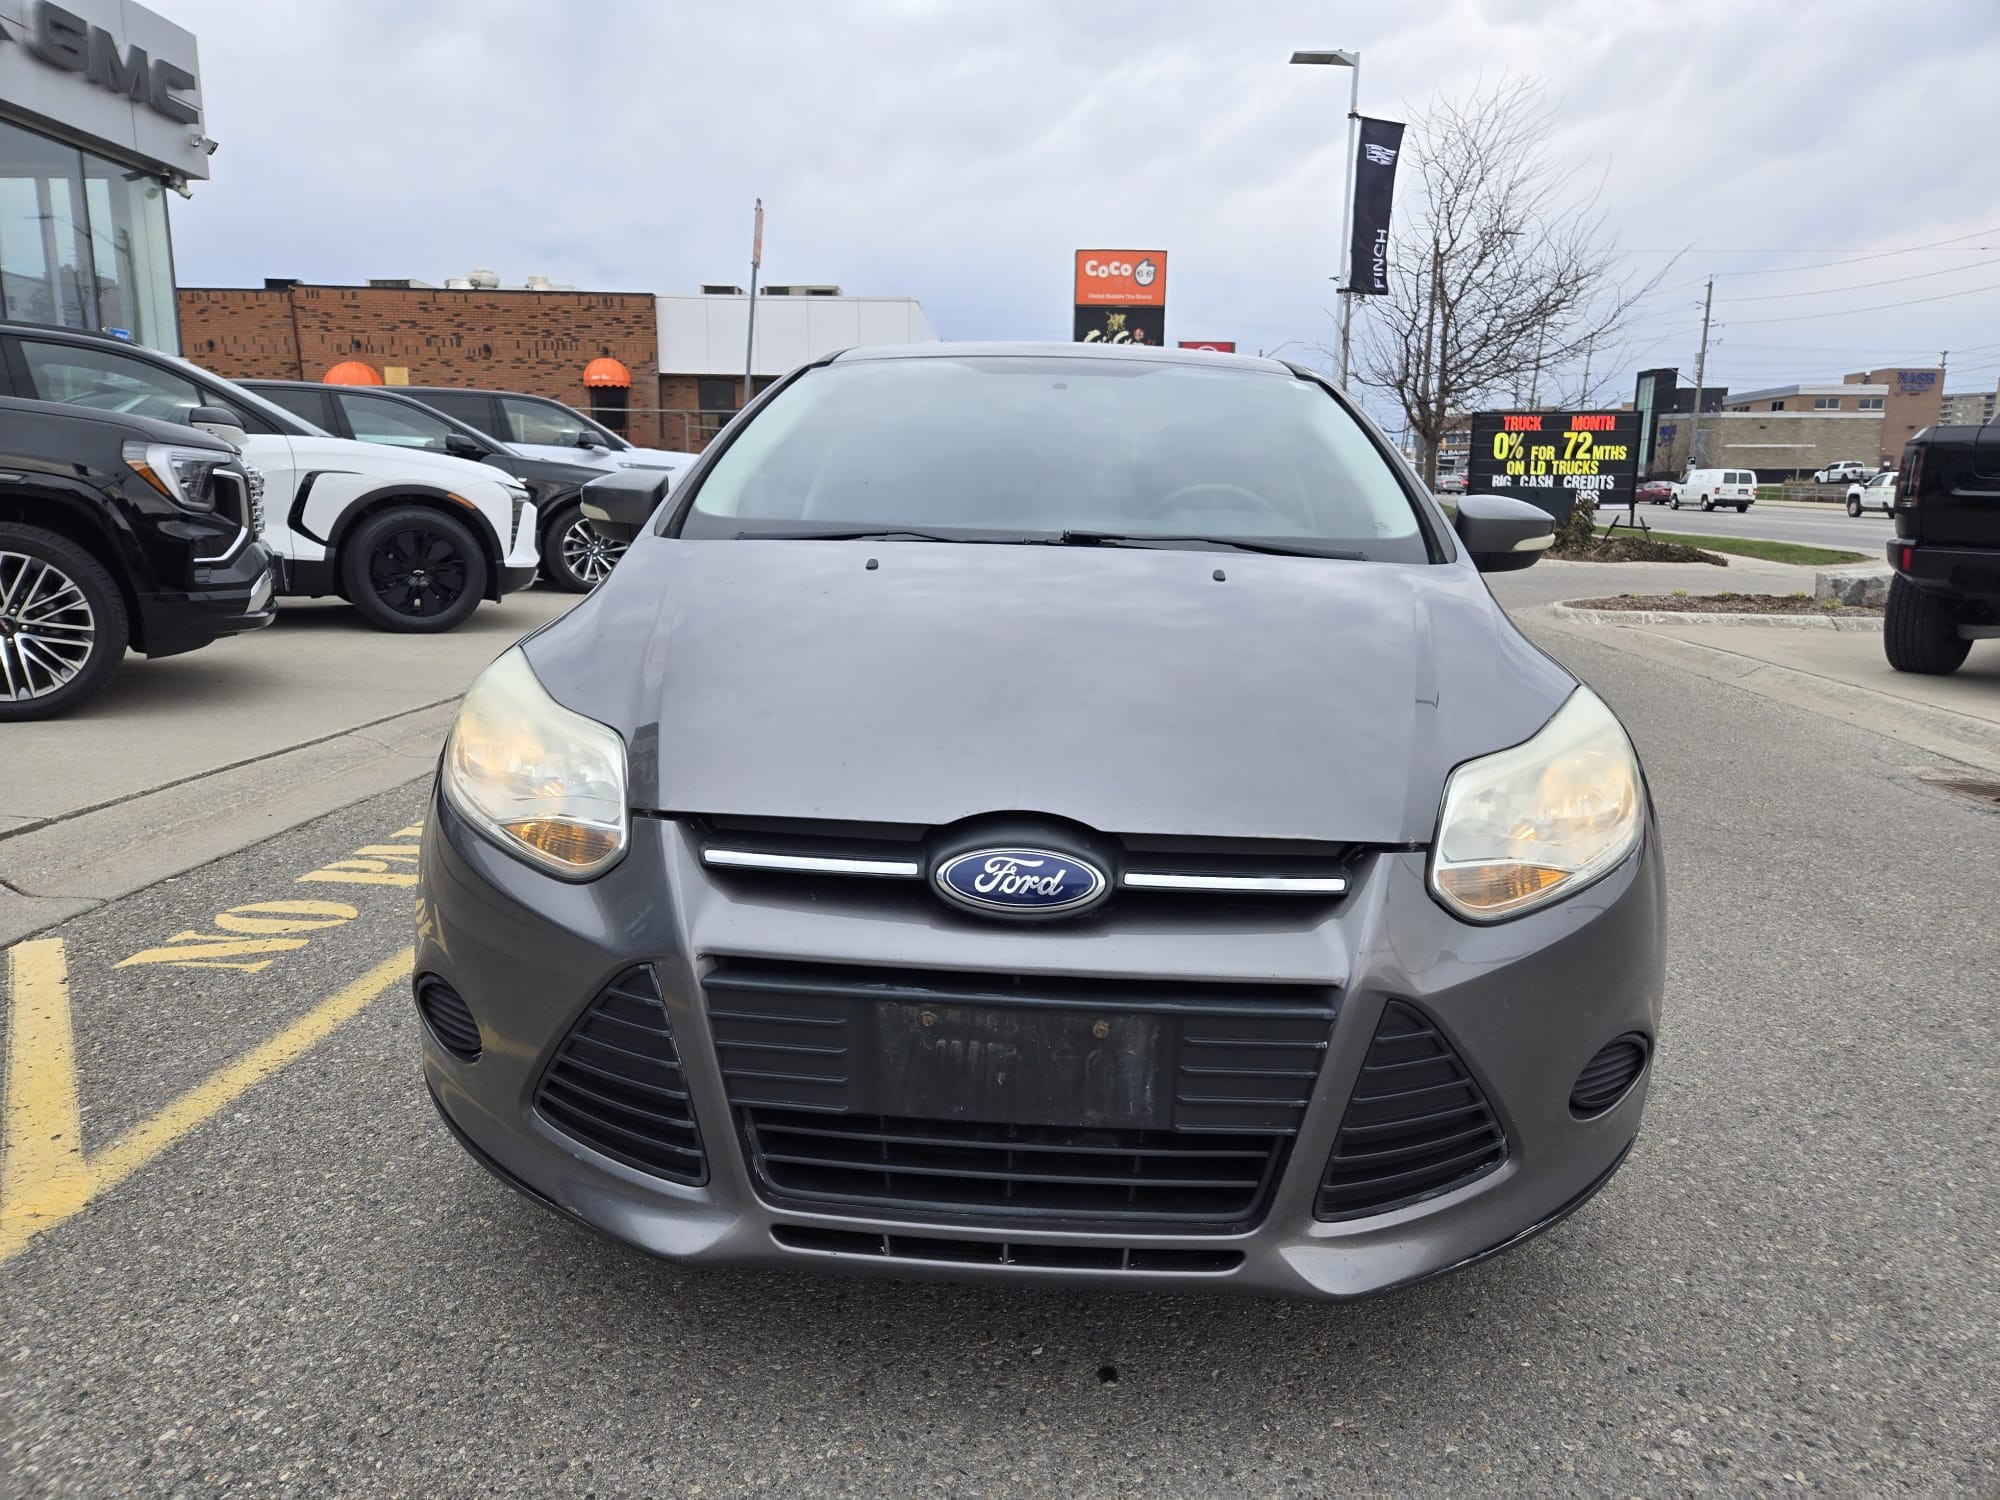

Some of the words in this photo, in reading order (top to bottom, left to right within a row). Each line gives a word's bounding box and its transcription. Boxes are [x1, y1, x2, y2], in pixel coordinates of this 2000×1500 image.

[33, 0, 200, 125] GMC
[1373, 229, 1388, 289] FINCH
[1504, 416, 1542, 431] TRUCK
[1571, 415, 1616, 431] MONTH
[1493, 432, 1524, 460] 0%
[1531, 445, 1555, 461] FOR
[1563, 431, 1593, 460] 72
[1592, 445, 1628, 461] MTHS
[1507, 461, 1525, 475] ON
[1530, 461, 1546, 475] LD
[1551, 460, 1599, 475] TRUCKS
[1520, 475, 1553, 488] CASH
[1563, 475, 1615, 490] CREDITS
[974, 856, 1066, 896] Ford
[112, 900, 359, 973] NO
